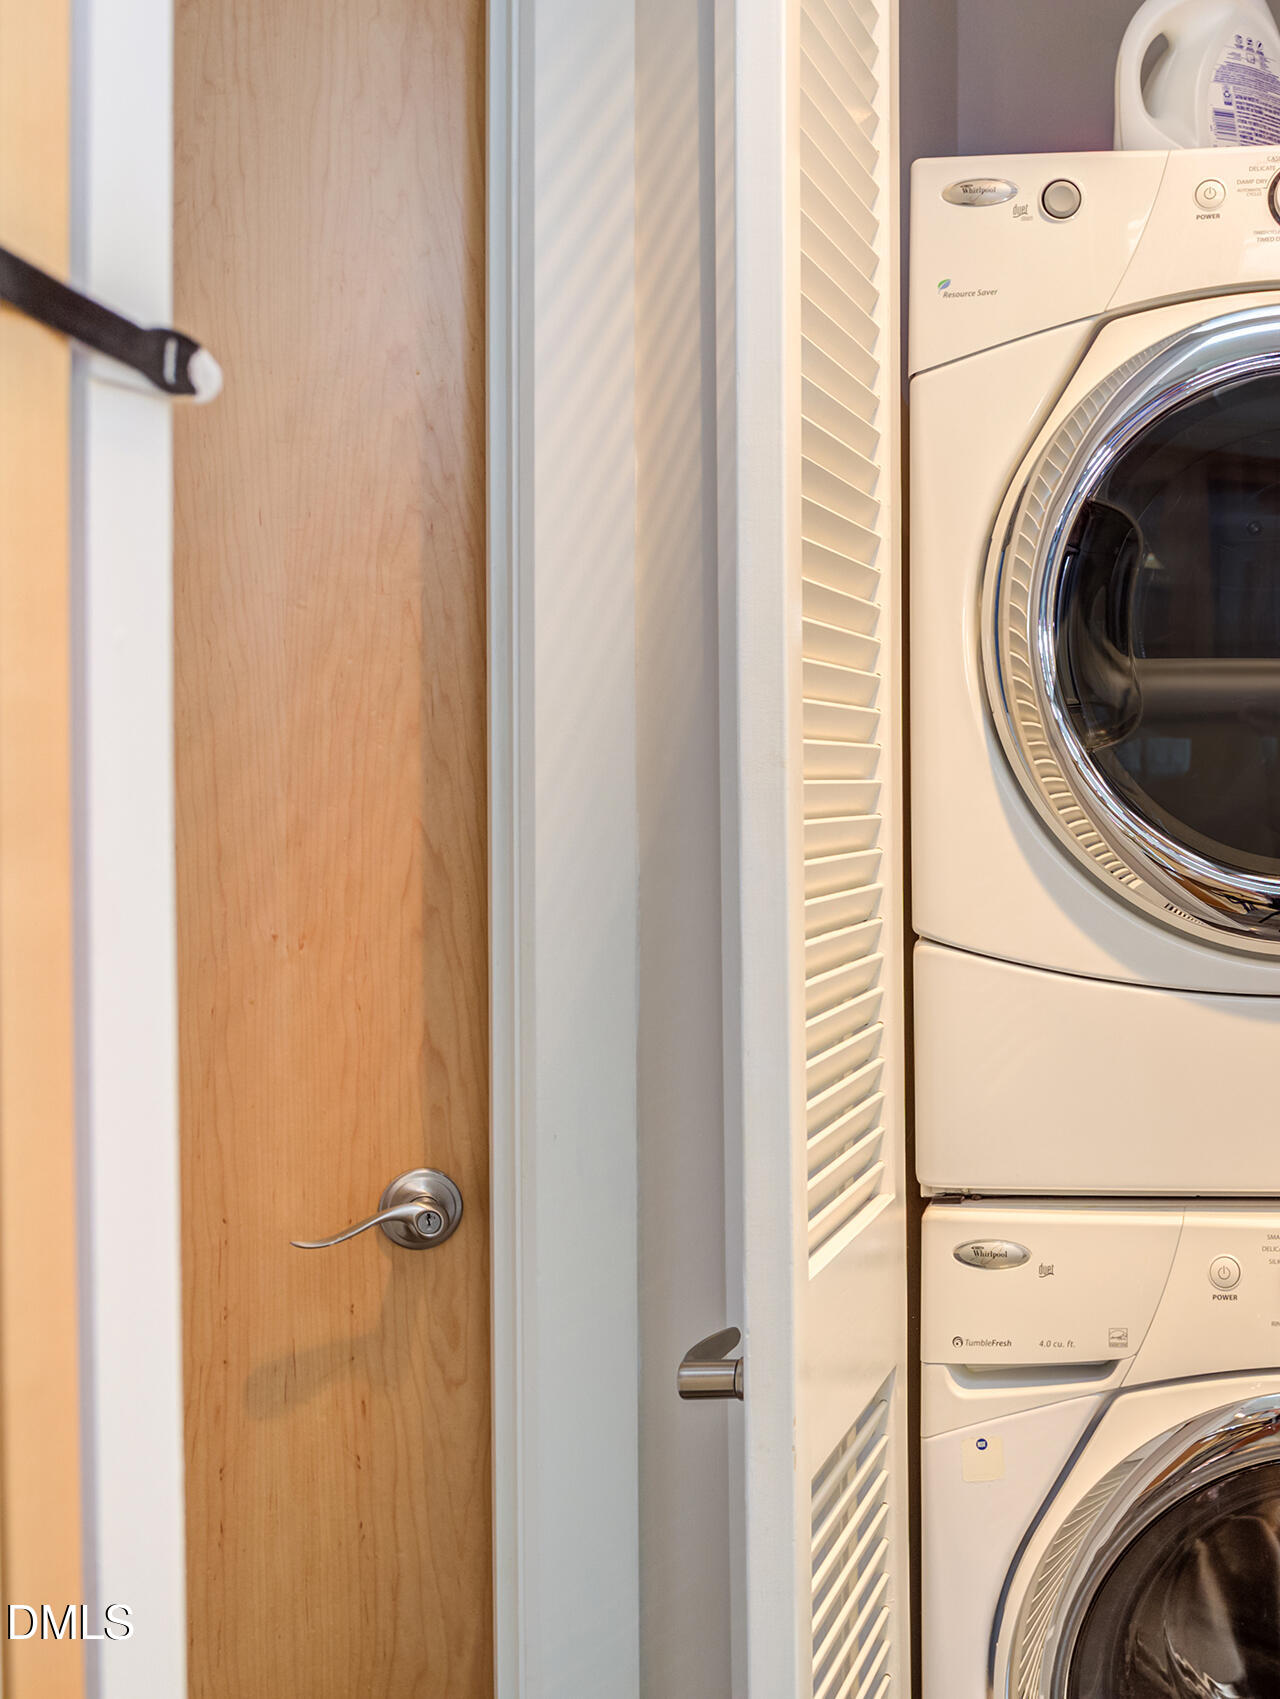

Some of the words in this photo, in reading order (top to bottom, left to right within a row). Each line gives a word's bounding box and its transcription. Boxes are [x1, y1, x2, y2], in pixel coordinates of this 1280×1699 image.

[961, 187, 997, 195] Whirlpool
[1012, 203, 1029, 218] duet
[943, 290, 976, 298] Resource
[977, 288, 998, 296] Saver
[973, 1250, 1008, 1259] Whirlpool
[1038, 1263, 1054, 1278] duet
[965, 1339, 1012, 1348] TumbleFresh
[1038, 1340, 1051, 1348] 4.0
[1066, 1339, 1076, 1348] ft.
